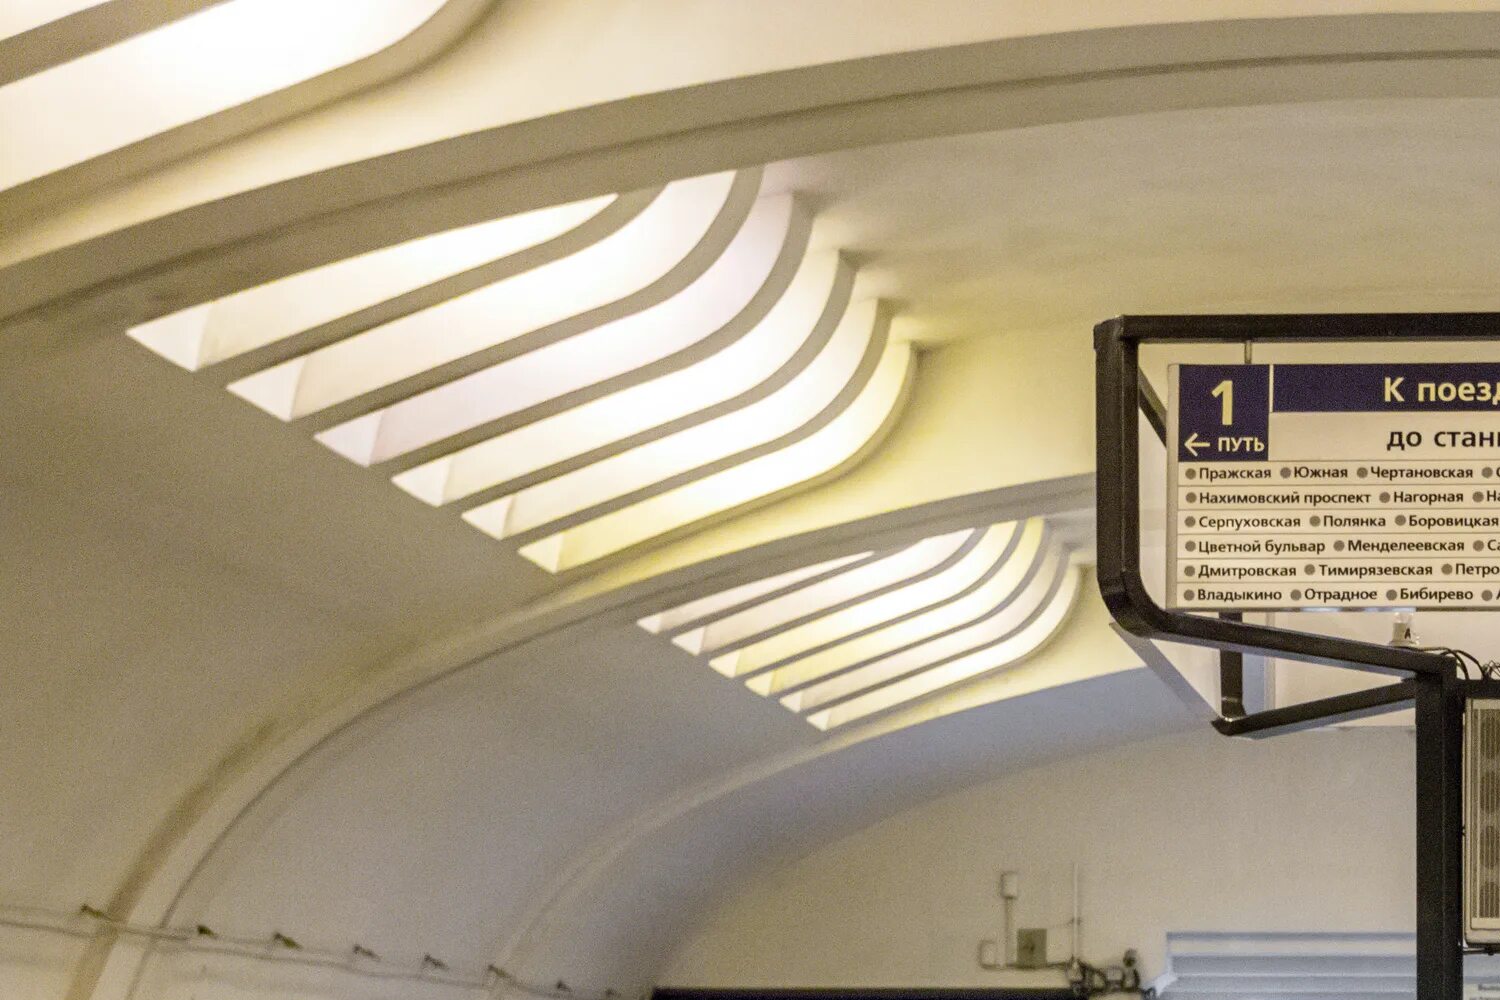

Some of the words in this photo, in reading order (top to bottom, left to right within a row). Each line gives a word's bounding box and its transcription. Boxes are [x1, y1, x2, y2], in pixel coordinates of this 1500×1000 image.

[1384, 376, 1405, 402] К
[1211, 380, 1233, 426] 1
[1218, 436, 1265, 452] ПУТЬ
[1386, 431, 1422, 451] до
[1199, 467, 1272, 483] Пражская
[1293, 466, 1348, 478] Южная
[1370, 466, 1474, 482] Чертановская
[1199, 491, 1300, 504] Нахимовский
[1303, 494, 1371, 507] проспект
[1393, 491, 1464, 506] Нагорная
[1198, 515, 1301, 531] Серпуховская
[1323, 515, 1386, 527] Полянка
[1408, 514, 1499, 530] Боровицкая
[1198, 540, 1261, 555] Цветной
[1264, 539, 1326, 556] бульвар
[1347, 539, 1465, 553] Менделеевская
[1197, 564, 1297, 580] Дмитровская
[1318, 564, 1433, 579] Тимирязевская
[1197, 588, 1282, 603] Владыкино
[1304, 588, 1378, 603] Отрадное
[1400, 586, 1474, 603] Бибирево
